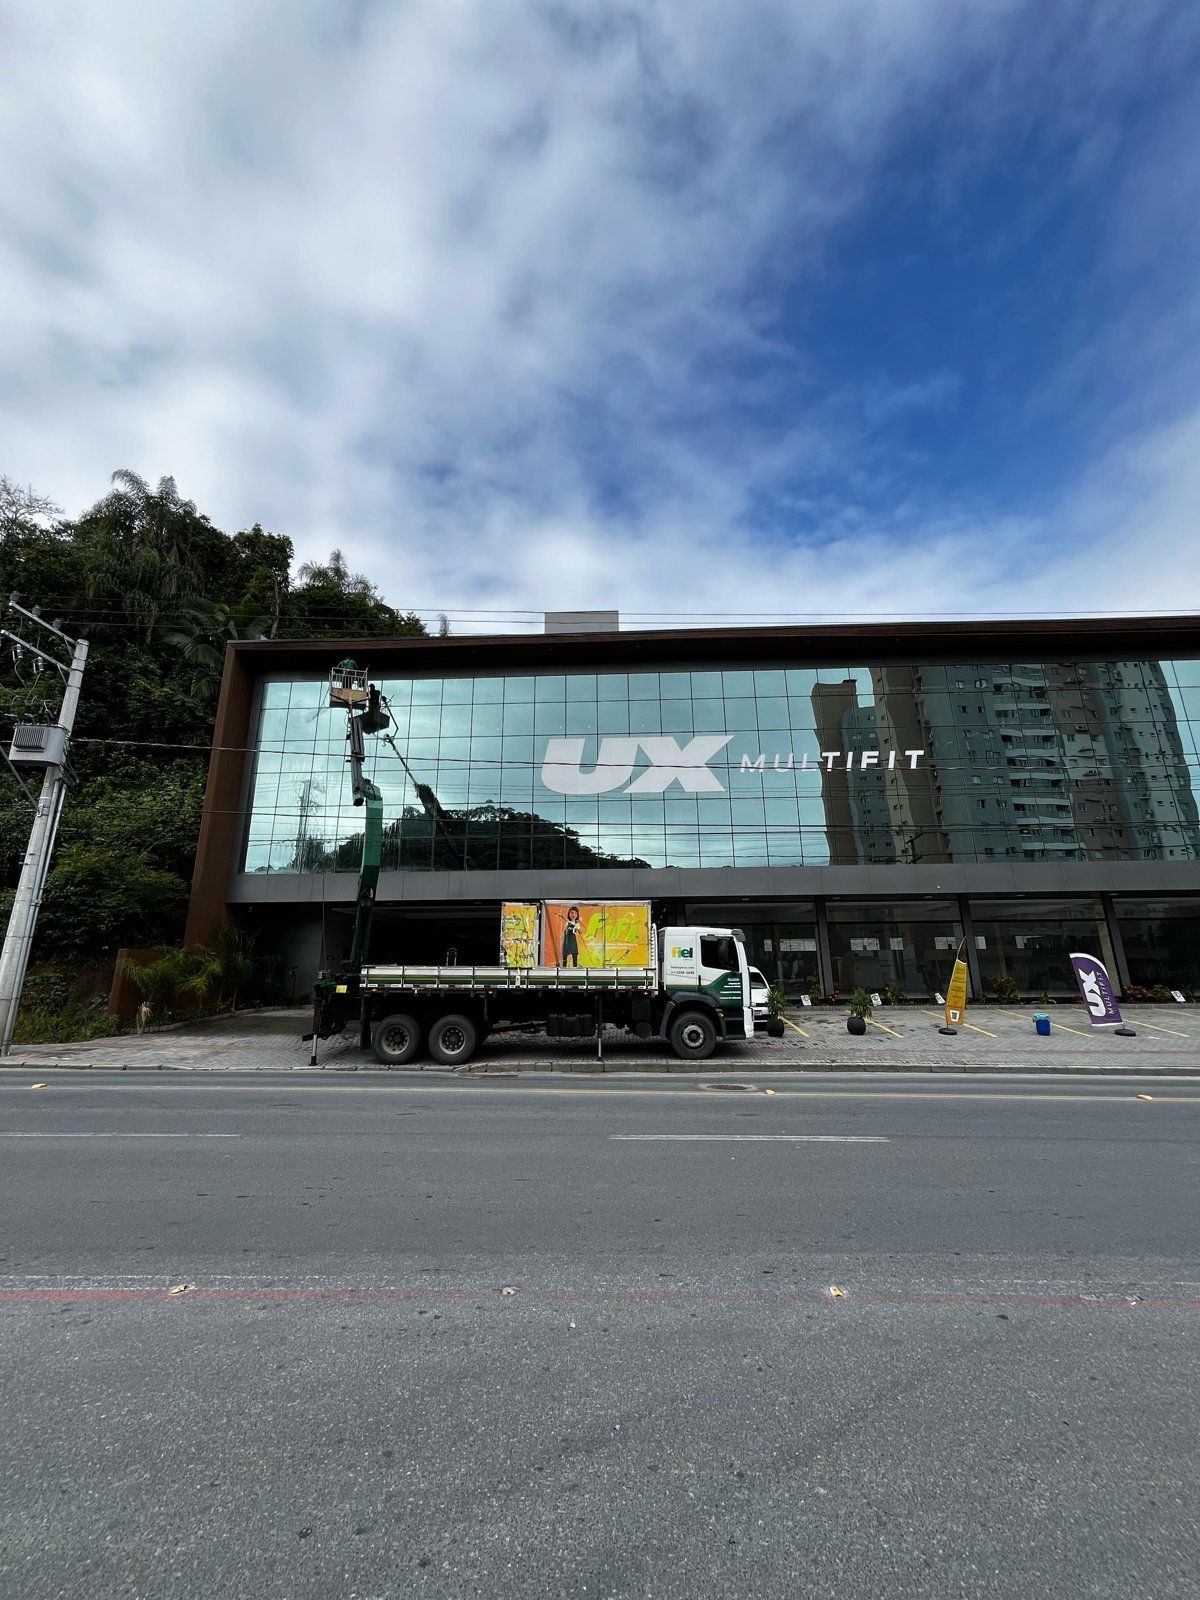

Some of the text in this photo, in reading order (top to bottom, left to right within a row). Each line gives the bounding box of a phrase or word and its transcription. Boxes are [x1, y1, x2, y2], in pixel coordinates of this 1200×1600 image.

[541, 735, 925, 795] UX MULTIFIT
[671, 946, 694, 959] fiel
[1078, 968, 1107, 1017] UX
[1096, 971, 1115, 1015] MULTIFIT
